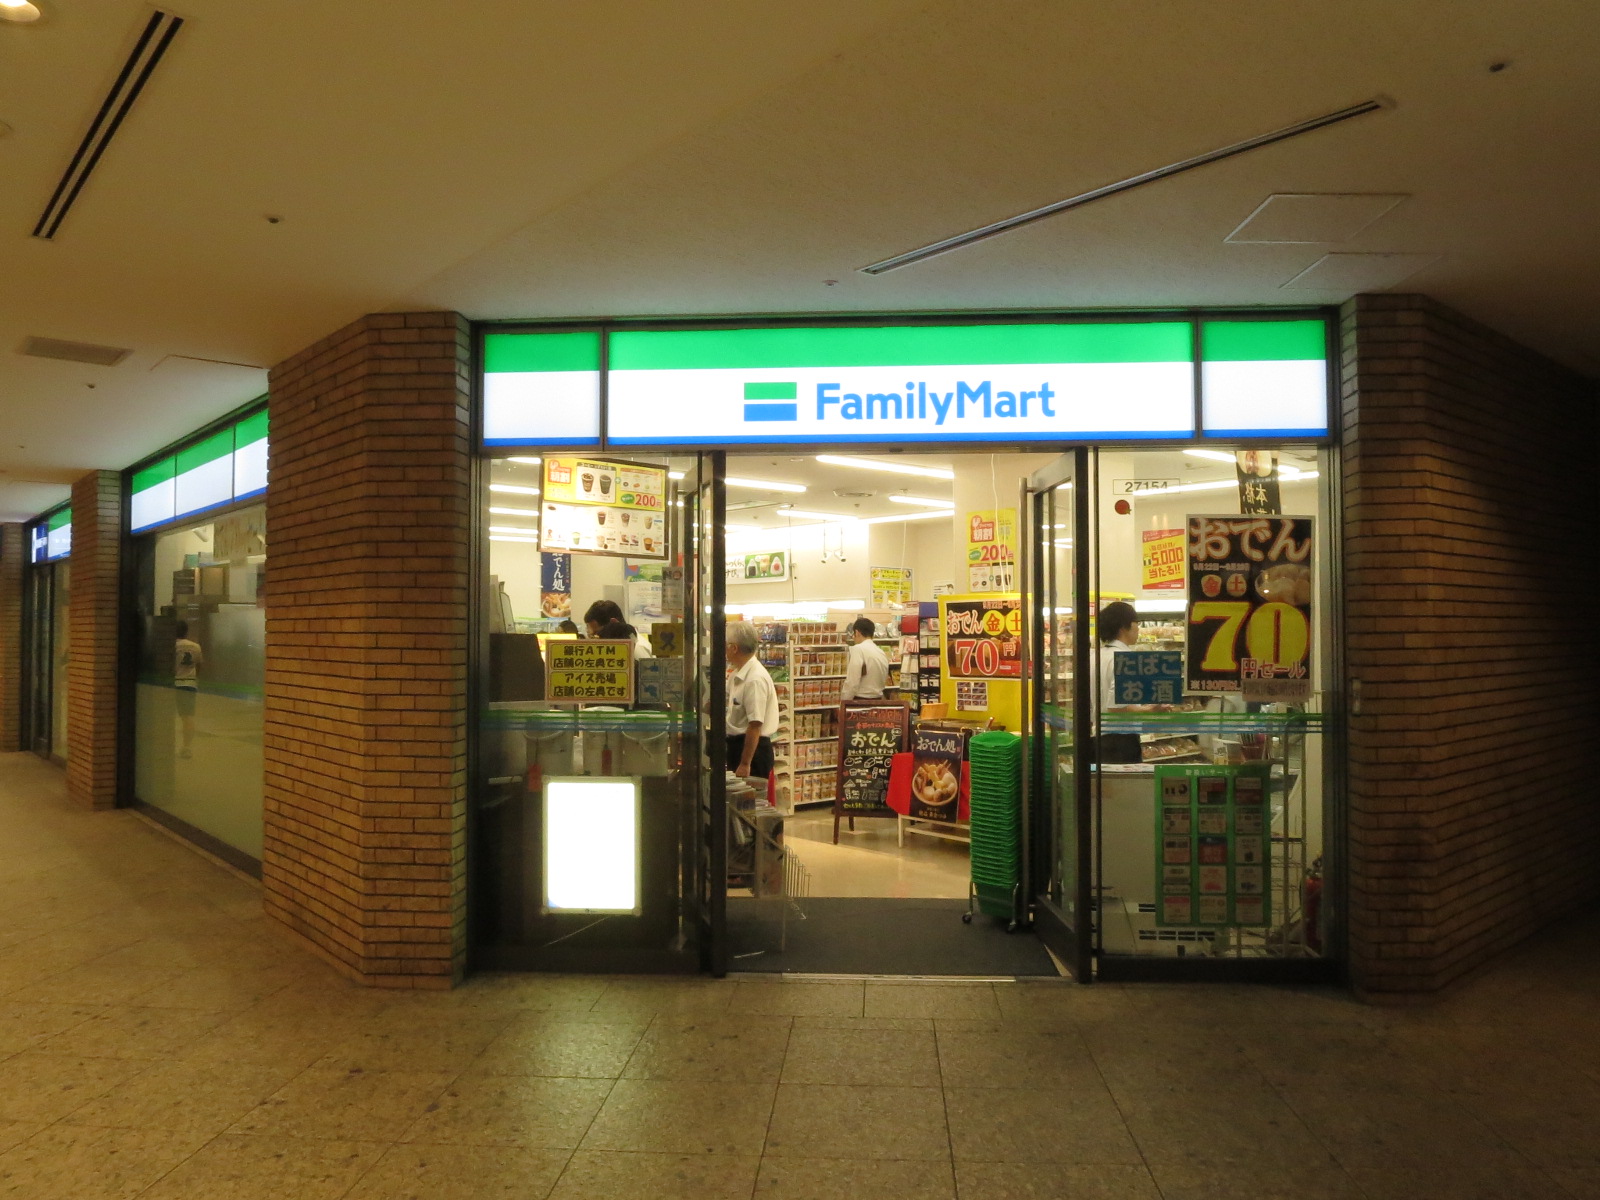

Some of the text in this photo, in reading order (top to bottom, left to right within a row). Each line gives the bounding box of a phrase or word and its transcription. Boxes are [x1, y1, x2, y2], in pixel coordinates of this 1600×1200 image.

[816, 380, 1056, 425] FamilyMart
[1124, 481, 1168, 492] 27154
[1190, 517, 1311, 562] おでん
[1228, 576, 1245, 592] 土
[947, 609, 983, 635] おでん
[987, 613, 1001, 632] 金
[1190, 602, 1310, 671] 70
[563, 646, 616, 656] 銀行ATM
[1115, 653, 1181, 676] たばこ
[1241, 658, 1307, 680] 円セール
[564, 673, 617, 684] アイス売場
[1122, 680, 1174, 704] お酒
[851, 731, 896, 748] おでん
[917, 736, 956, 753] おでん処
